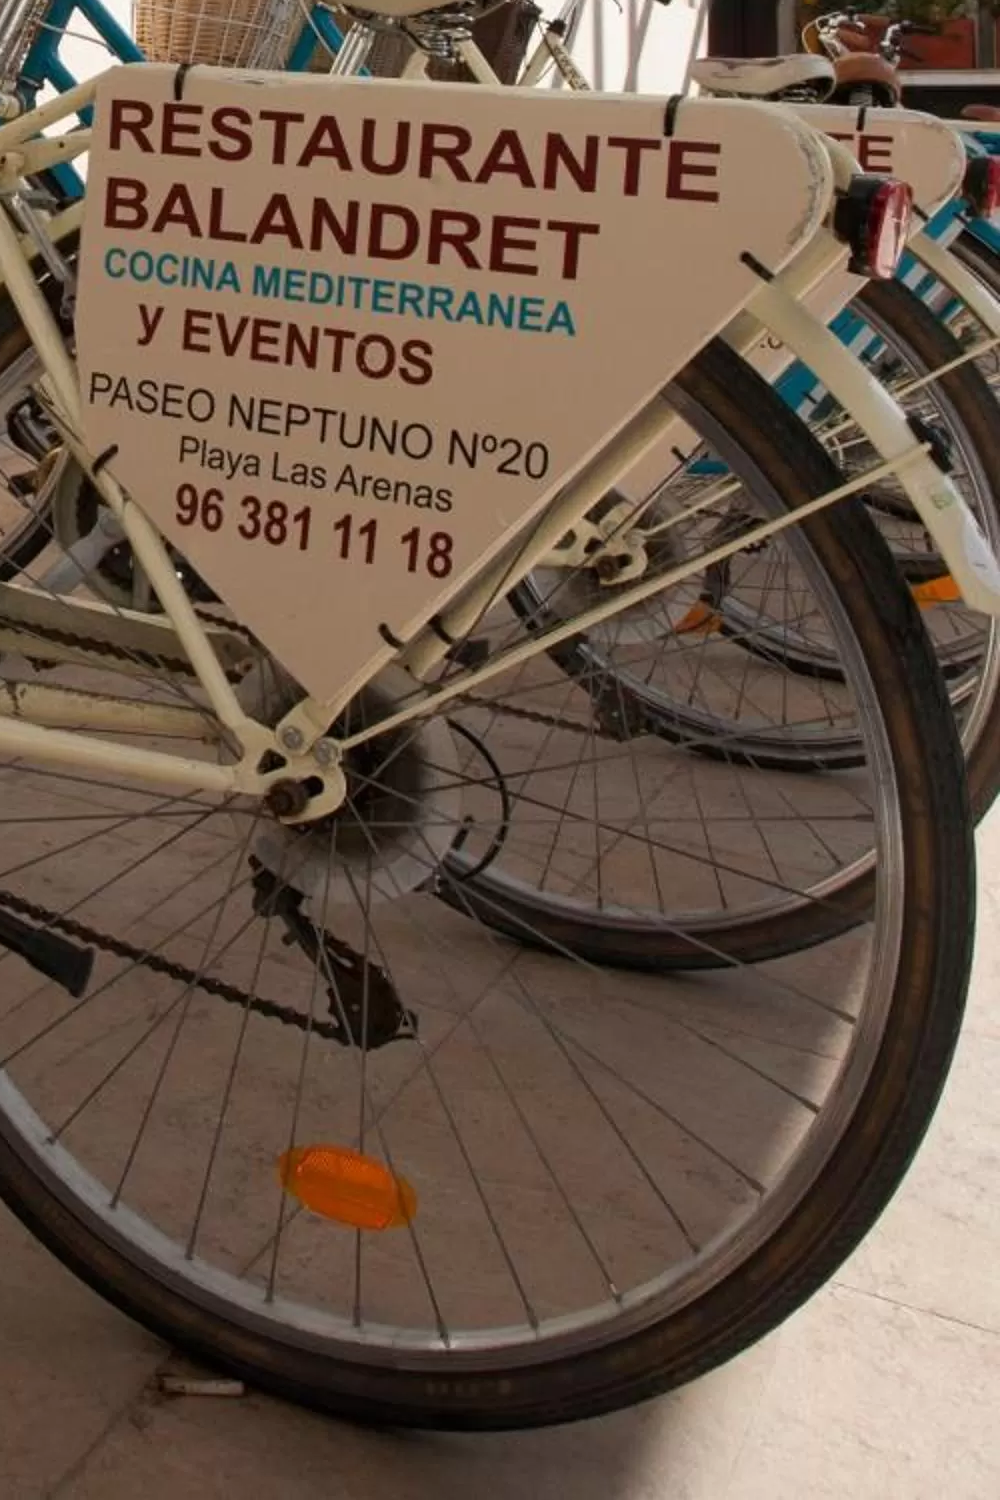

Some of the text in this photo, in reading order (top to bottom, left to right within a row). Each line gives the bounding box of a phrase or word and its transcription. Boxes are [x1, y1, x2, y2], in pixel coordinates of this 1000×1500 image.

[108, 99, 722, 203] RESTAURANTE
[104, 176, 600, 281] BALANDRET
[103, 247, 576, 338] COCINA MEDITERRANEA
[181, 308, 434, 386] EVENTOS
[88, 371, 215, 423] PASEO
[227, 393, 433, 460] NEPTUNO
[178, 434, 453, 513] Playa Las Arenas
[175, 482, 454, 579] 96 381 11 18
